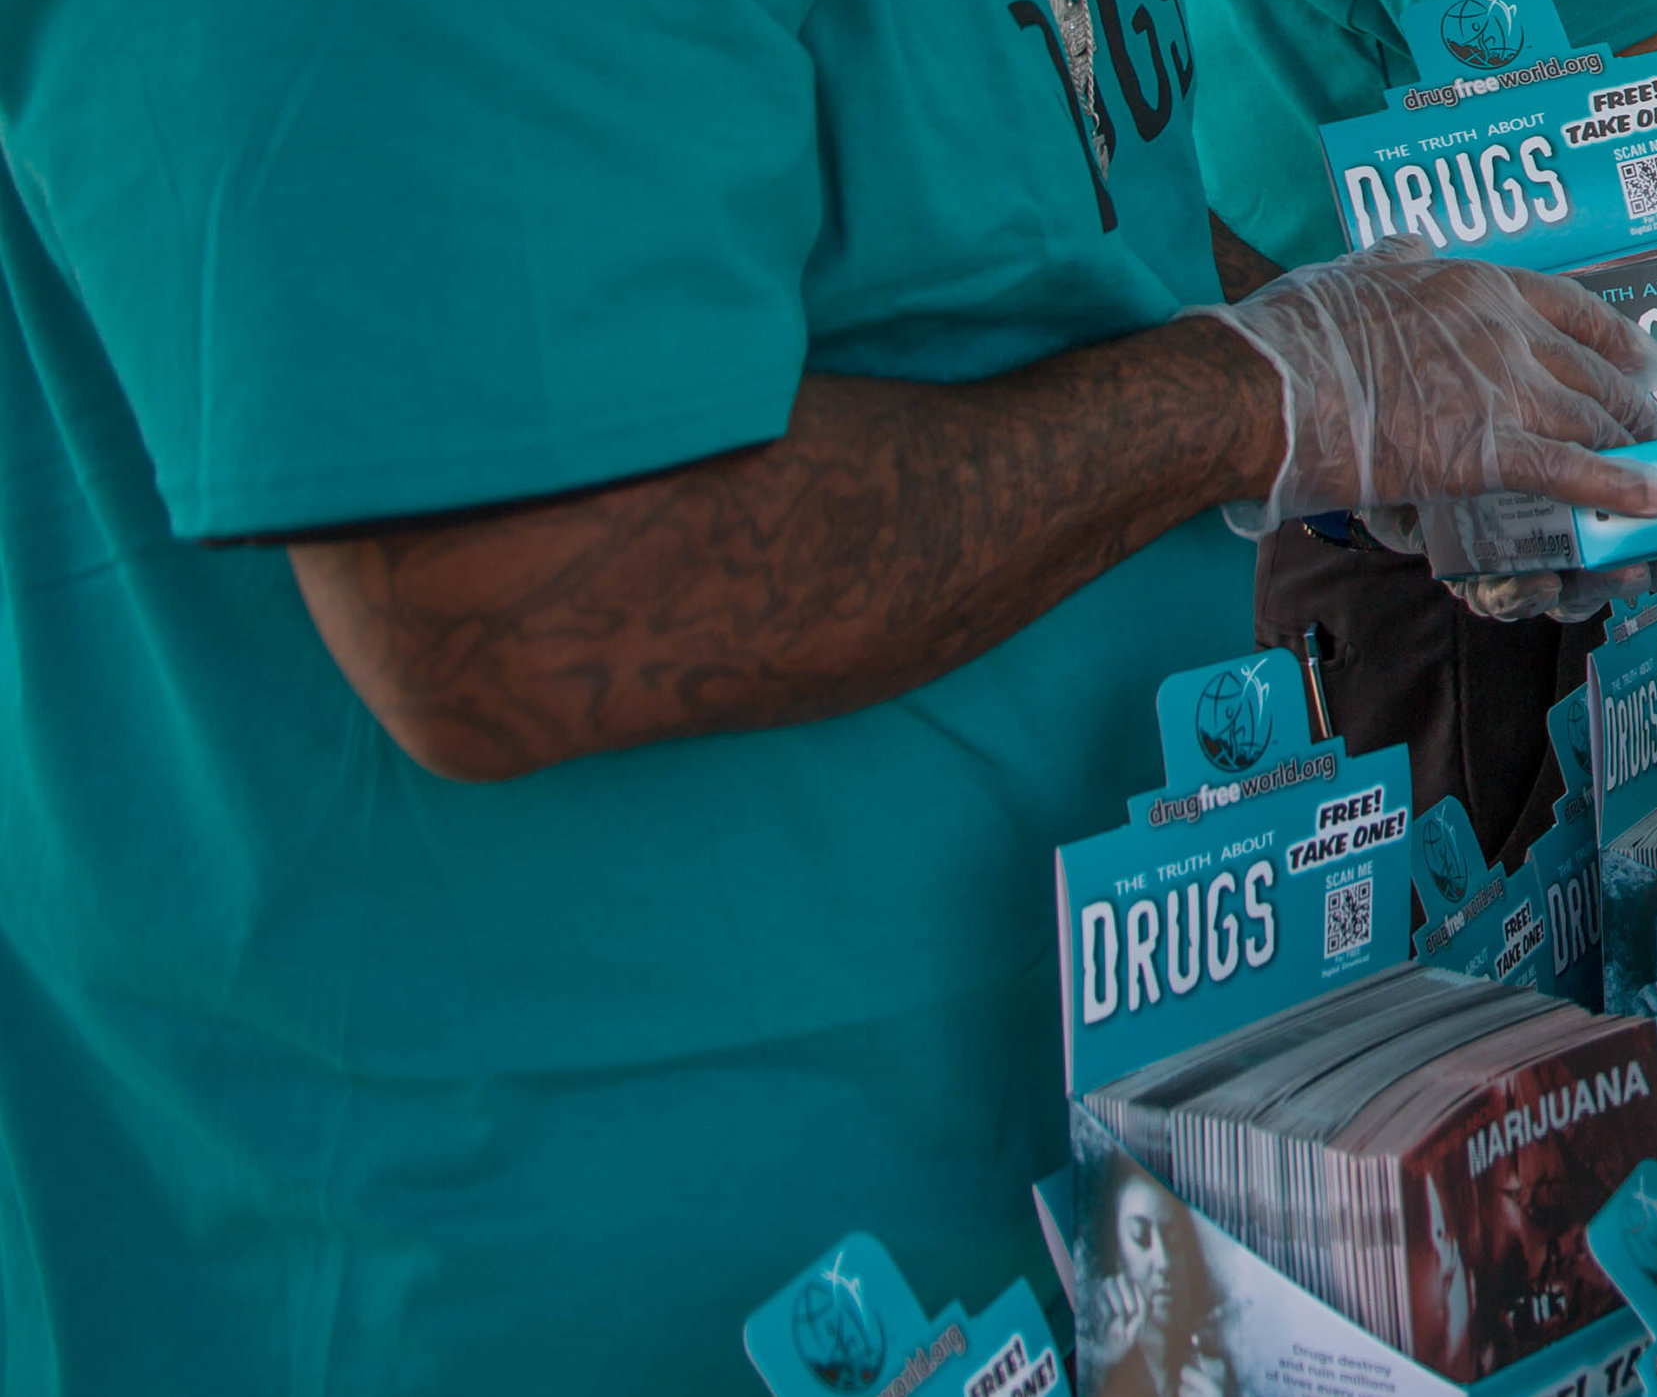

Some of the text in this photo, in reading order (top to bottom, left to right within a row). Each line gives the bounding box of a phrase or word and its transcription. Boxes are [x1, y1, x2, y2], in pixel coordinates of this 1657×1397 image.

[1403, 53, 1603, 111] drugfreeworld.org
[1374, 112, 1546, 162] THE TRUTH ABOUT
[1565, 114, 1631, 145] TAKE
[1613, 143, 1647, 161] SCAN
[1344, 136, 1569, 249] DRUGS
[1149, 753, 1335, 828] drugfreeworld.org
[1319, 788, 1382, 830] FREE!
[1114, 831, 1276, 897] THE TRUTH ABOUT
[1289, 811, 1406, 870] TAKE ONE!
[1325, 861, 1374, 890] SCAN ME
[1082, 860, 1275, 1025] DRUGS
[1505, 901, 1532, 942] FREE!
[1547, 860, 1601, 977] DRU
[1496, 918, 1544, 979] TAKE ONE!
[1467, 1059, 1650, 1180] MARIJUANA
[1265, 1369, 1279, 1382] of
[1283, 1374, 1313, 1391] lives
[1278, 1357, 1396, 1393] and ruin millions
[1292, 1344, 1392, 1378] Drugs destroy
